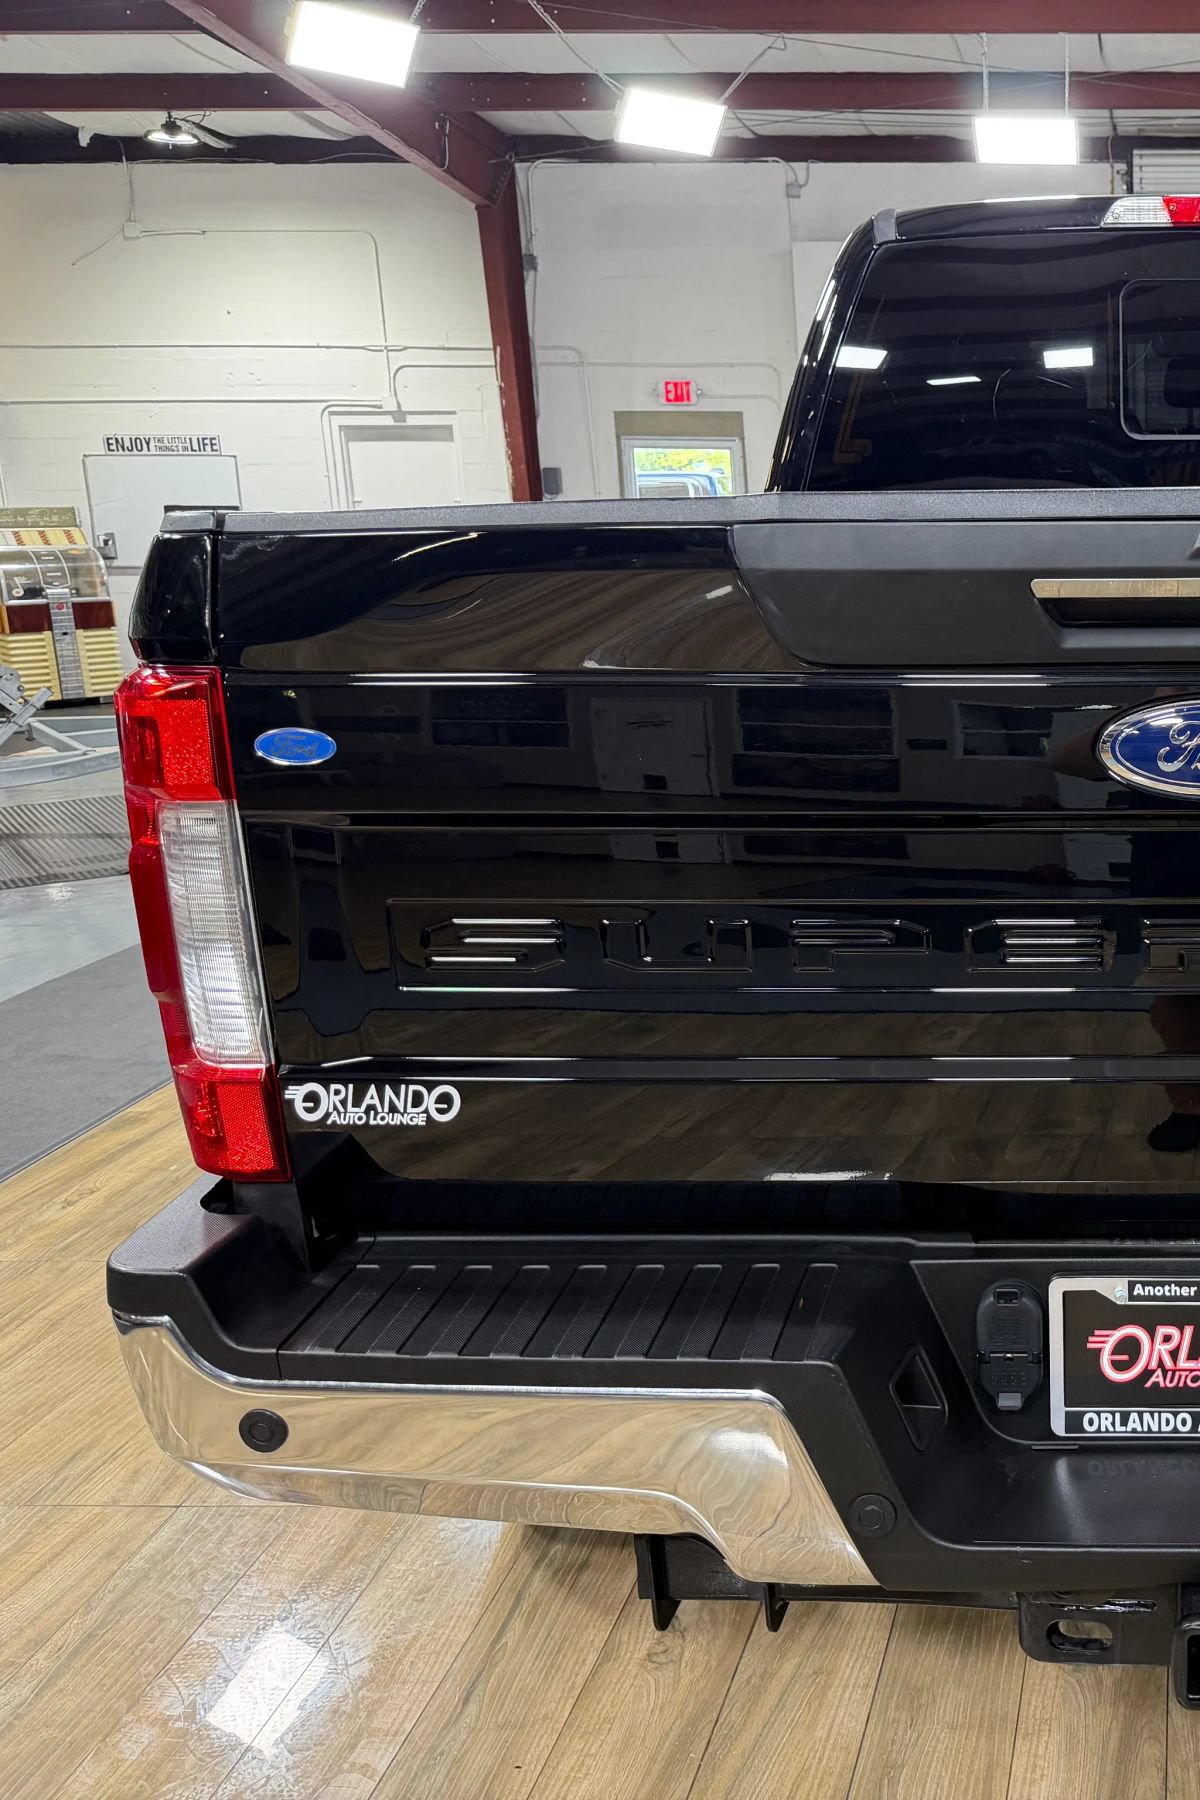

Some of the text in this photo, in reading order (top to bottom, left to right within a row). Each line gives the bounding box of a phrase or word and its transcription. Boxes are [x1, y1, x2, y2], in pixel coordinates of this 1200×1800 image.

[665, 381, 691, 403] EXIT
[106, 436, 152, 452] ENJOY
[153, 436, 188, 445] THE LITTLE
[154, 444, 190, 453] THINGS IN
[189, 436, 219, 453] LIFE
[271, 736, 319, 757] Ford
[285, 1082, 462, 1122] ORLANDO
[327, 1111, 427, 1126] AUTO LOUNGE
[1133, 1283, 1198, 1298] Another
[1082, 1412, 1193, 1433] ORLANDO
